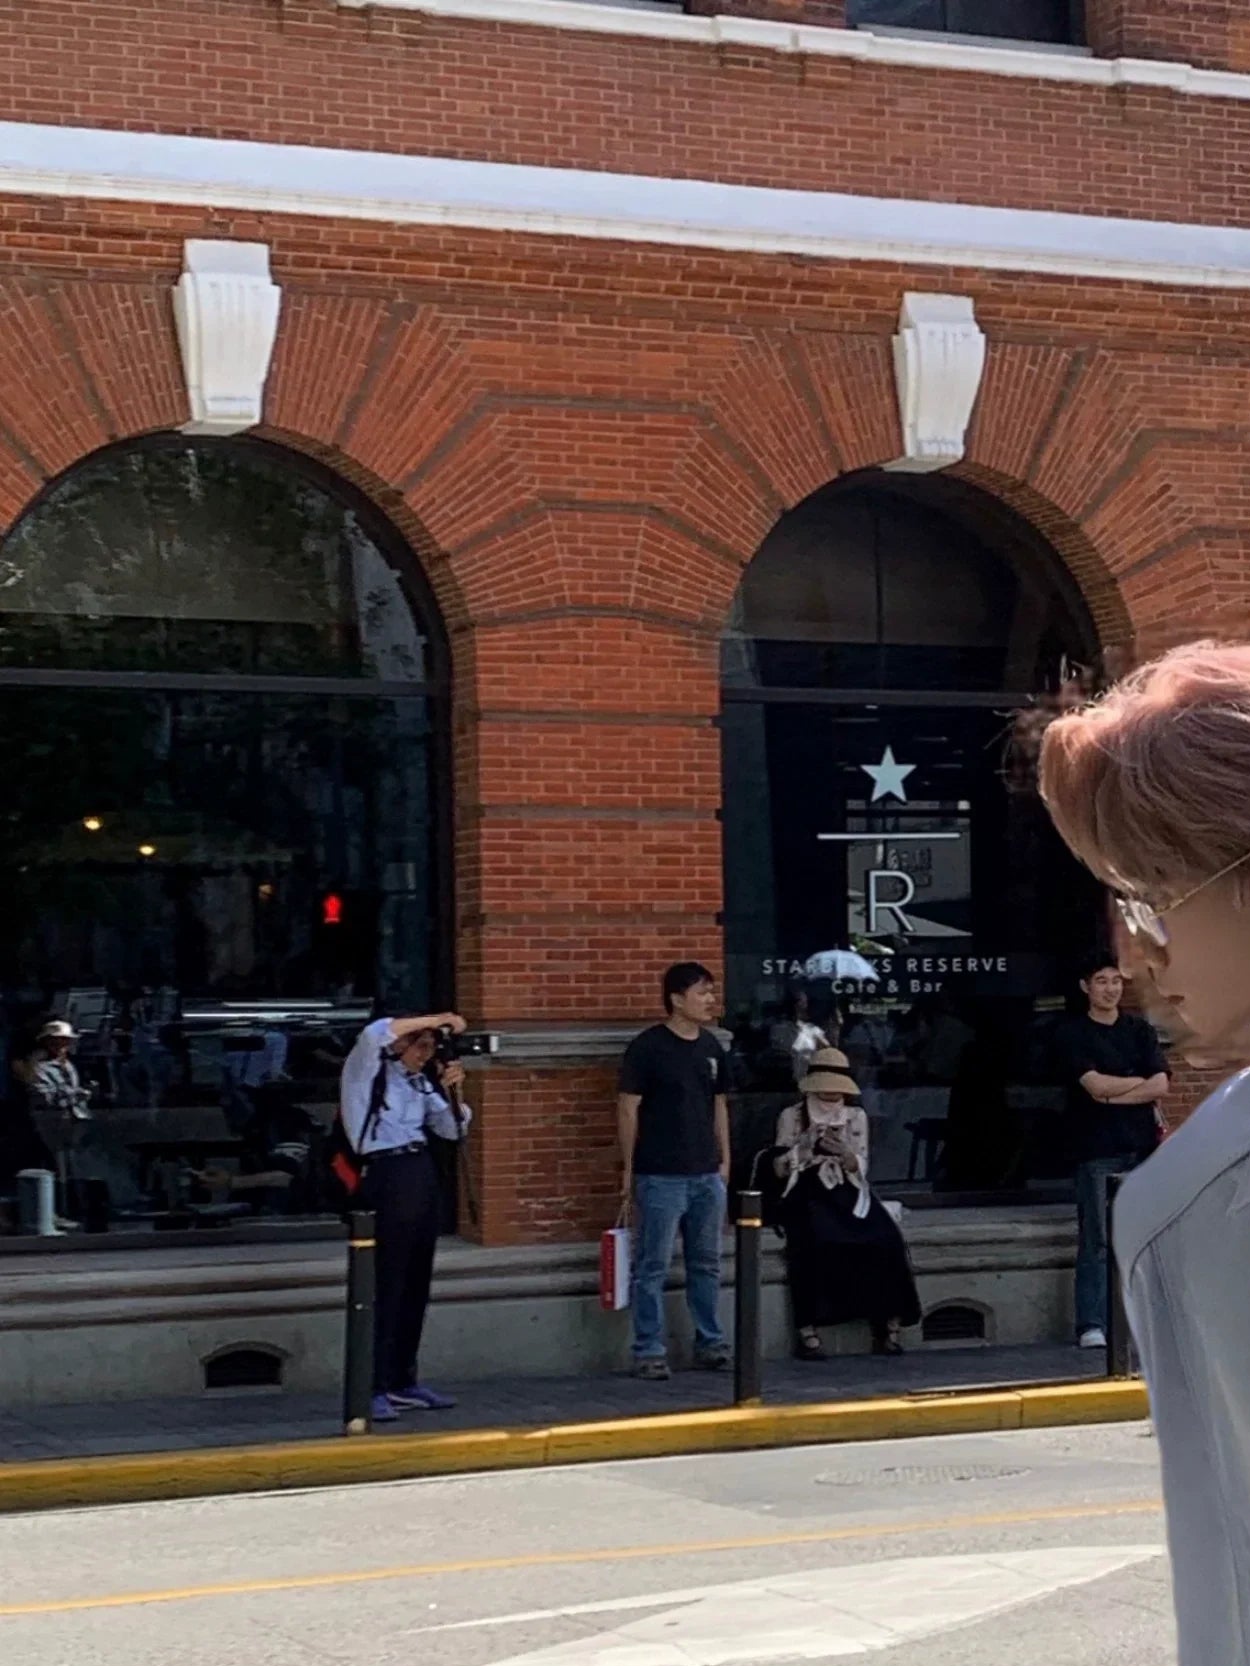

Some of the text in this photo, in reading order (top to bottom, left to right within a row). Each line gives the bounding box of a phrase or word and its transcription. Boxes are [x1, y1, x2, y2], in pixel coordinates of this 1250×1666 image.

[868, 869, 916, 933] R
[906, 957, 1008, 973] RESERVE
[831, 979, 943, 994] Cafe & Bar
